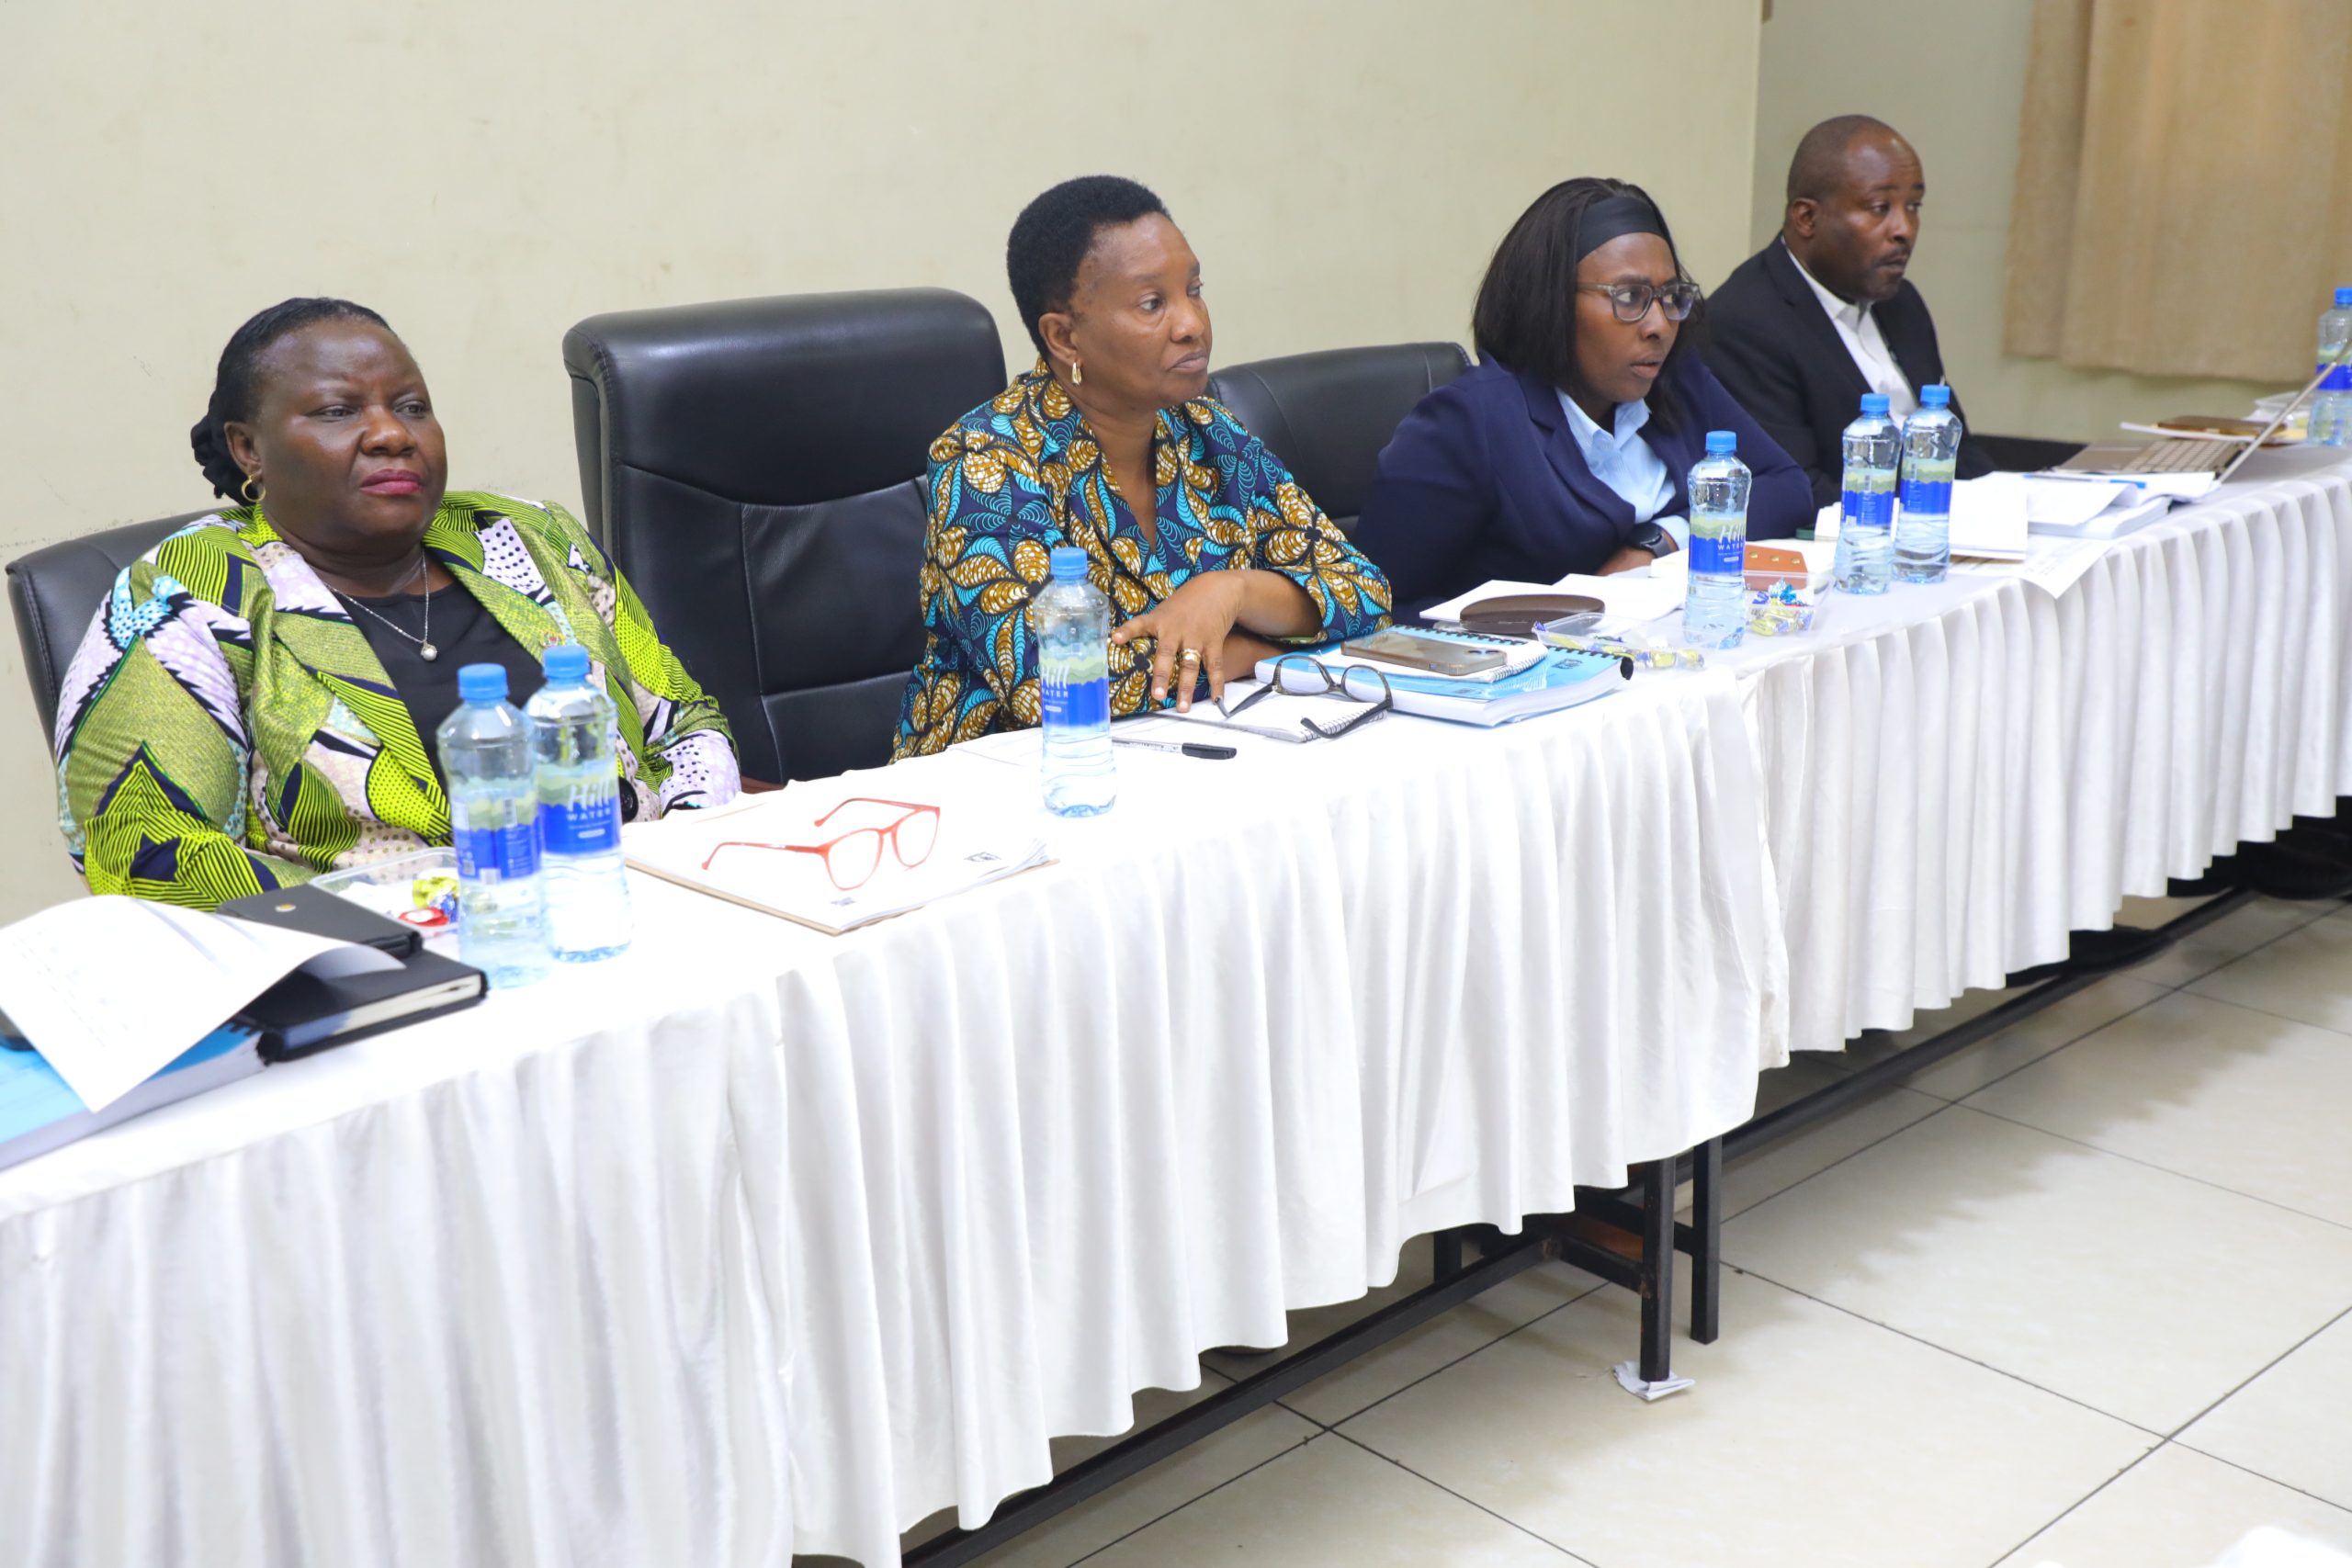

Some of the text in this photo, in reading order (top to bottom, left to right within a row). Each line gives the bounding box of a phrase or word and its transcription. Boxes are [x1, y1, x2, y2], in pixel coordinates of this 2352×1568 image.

[1719, 524, 1745, 544] Hill
[1040, 664, 1069, 690] Hill
[567, 780, 610, 812] Hill
